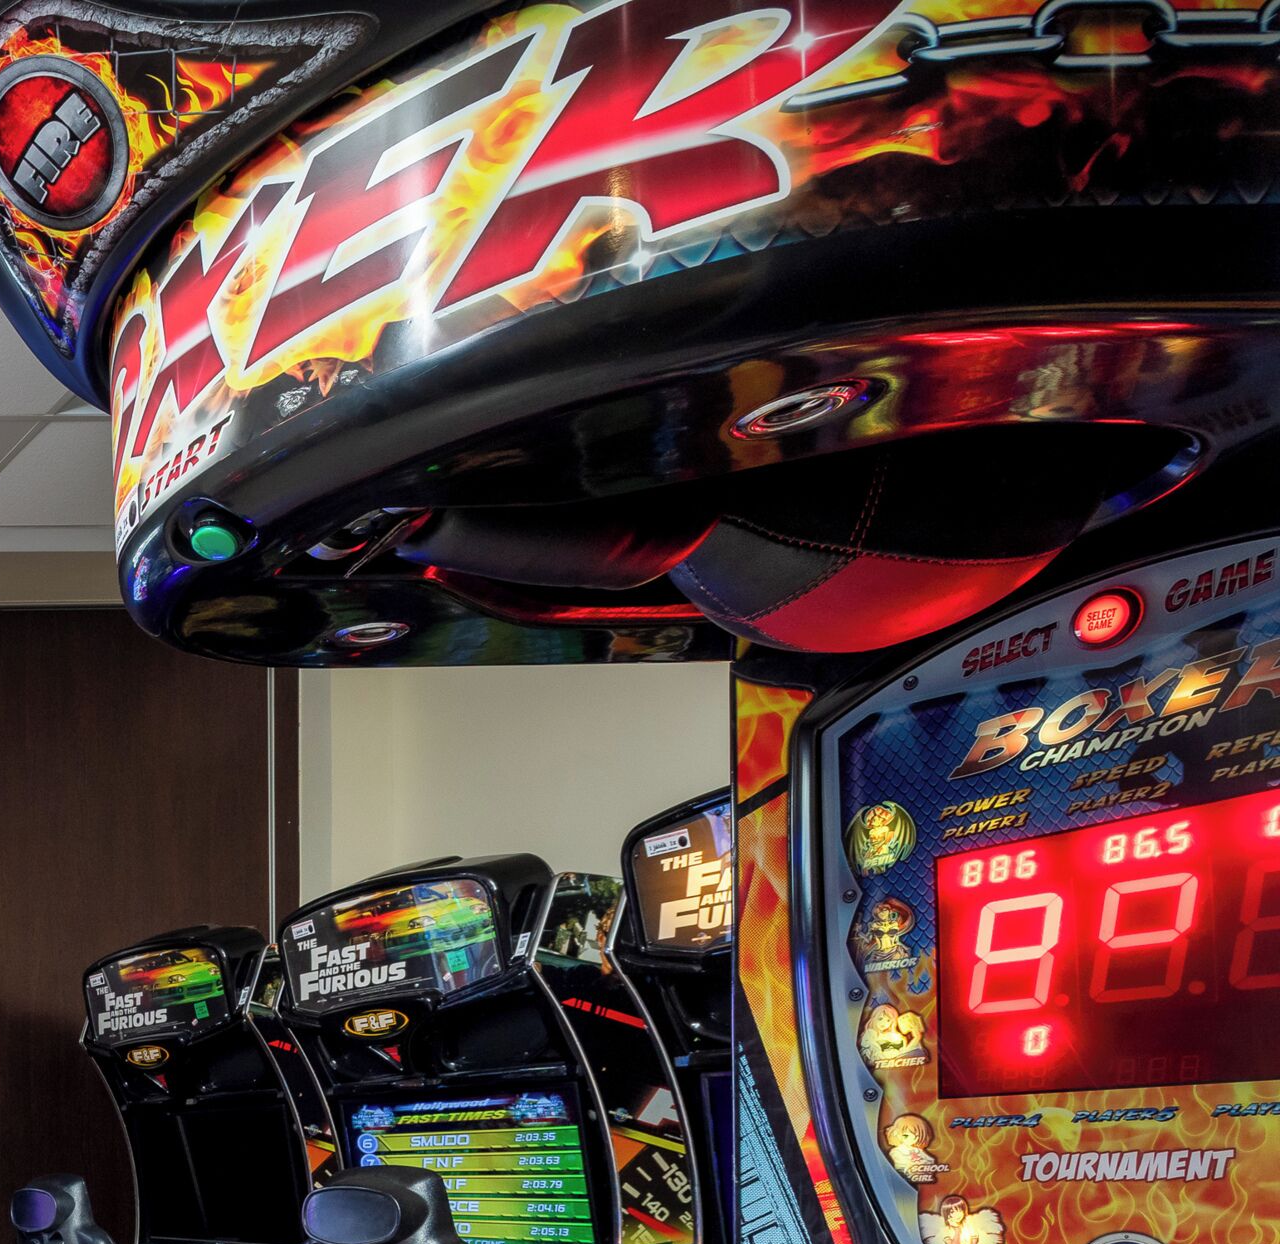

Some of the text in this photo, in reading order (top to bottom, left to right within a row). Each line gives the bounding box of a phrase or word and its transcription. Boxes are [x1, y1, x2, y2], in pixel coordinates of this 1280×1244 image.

[13, 93, 103, 205] FIRE
[141, 410, 234, 515] START
[1165, 549, 1277, 612] GAME
[1086, 607, 1118, 622] SELECT
[1088, 618, 1113, 631] GAME
[961, 622, 1058, 678] SELECT
[1019, 707, 1216, 773] CHAMPION
[1069, 755, 1168, 791] SPEED
[940, 787, 1033, 821] POWER
[660, 851, 704, 872] THE
[863, 854, 896, 869] DEVIL
[960, 849, 1037, 888] 886
[297, 938, 318, 951] THE
[310, 942, 371, 971] FAST
[863, 955, 918, 973] WARRIOR
[318, 962, 361, 978] AND THE
[299, 961, 407, 1001] FURIOUS
[95, 986, 109, 995] THE
[104, 991, 143, 1012] FAST
[110, 1007, 137, 1018] AND THE
[98, 1008, 168, 1035] FURIOUS
[352, 1012, 395, 1032] F&F
[1023, 1025, 1050, 1057] 0
[132, 1049, 162, 1063] F&F
[875, 1056, 926, 1070] TEACHER
[412, 1098, 492, 1112] Hollywood
[397, 1113, 441, 1125] FAST
[448, 1109, 508, 1122] TIMES
[949, 1113, 1043, 1129] PLAYER4
[1072, 1106, 1179, 1125] PLAYER5
[361, 1132, 556, 1149] 6 SMUDO 2:03.35
[518, 1156, 561, 1166] 2:03.63
[910, 1162, 950, 1174] SCHOOL
[1020, 1147, 1235, 1183] TOURNAMENT
[522, 1179, 563, 1189] 2:03.79
[910, 1173, 934, 1182] GIRL
[527, 1203, 566, 1213] 2:04.16
[641, 1193, 670, 1222] 140
[530, 1227, 569, 1236] 2:05.13
